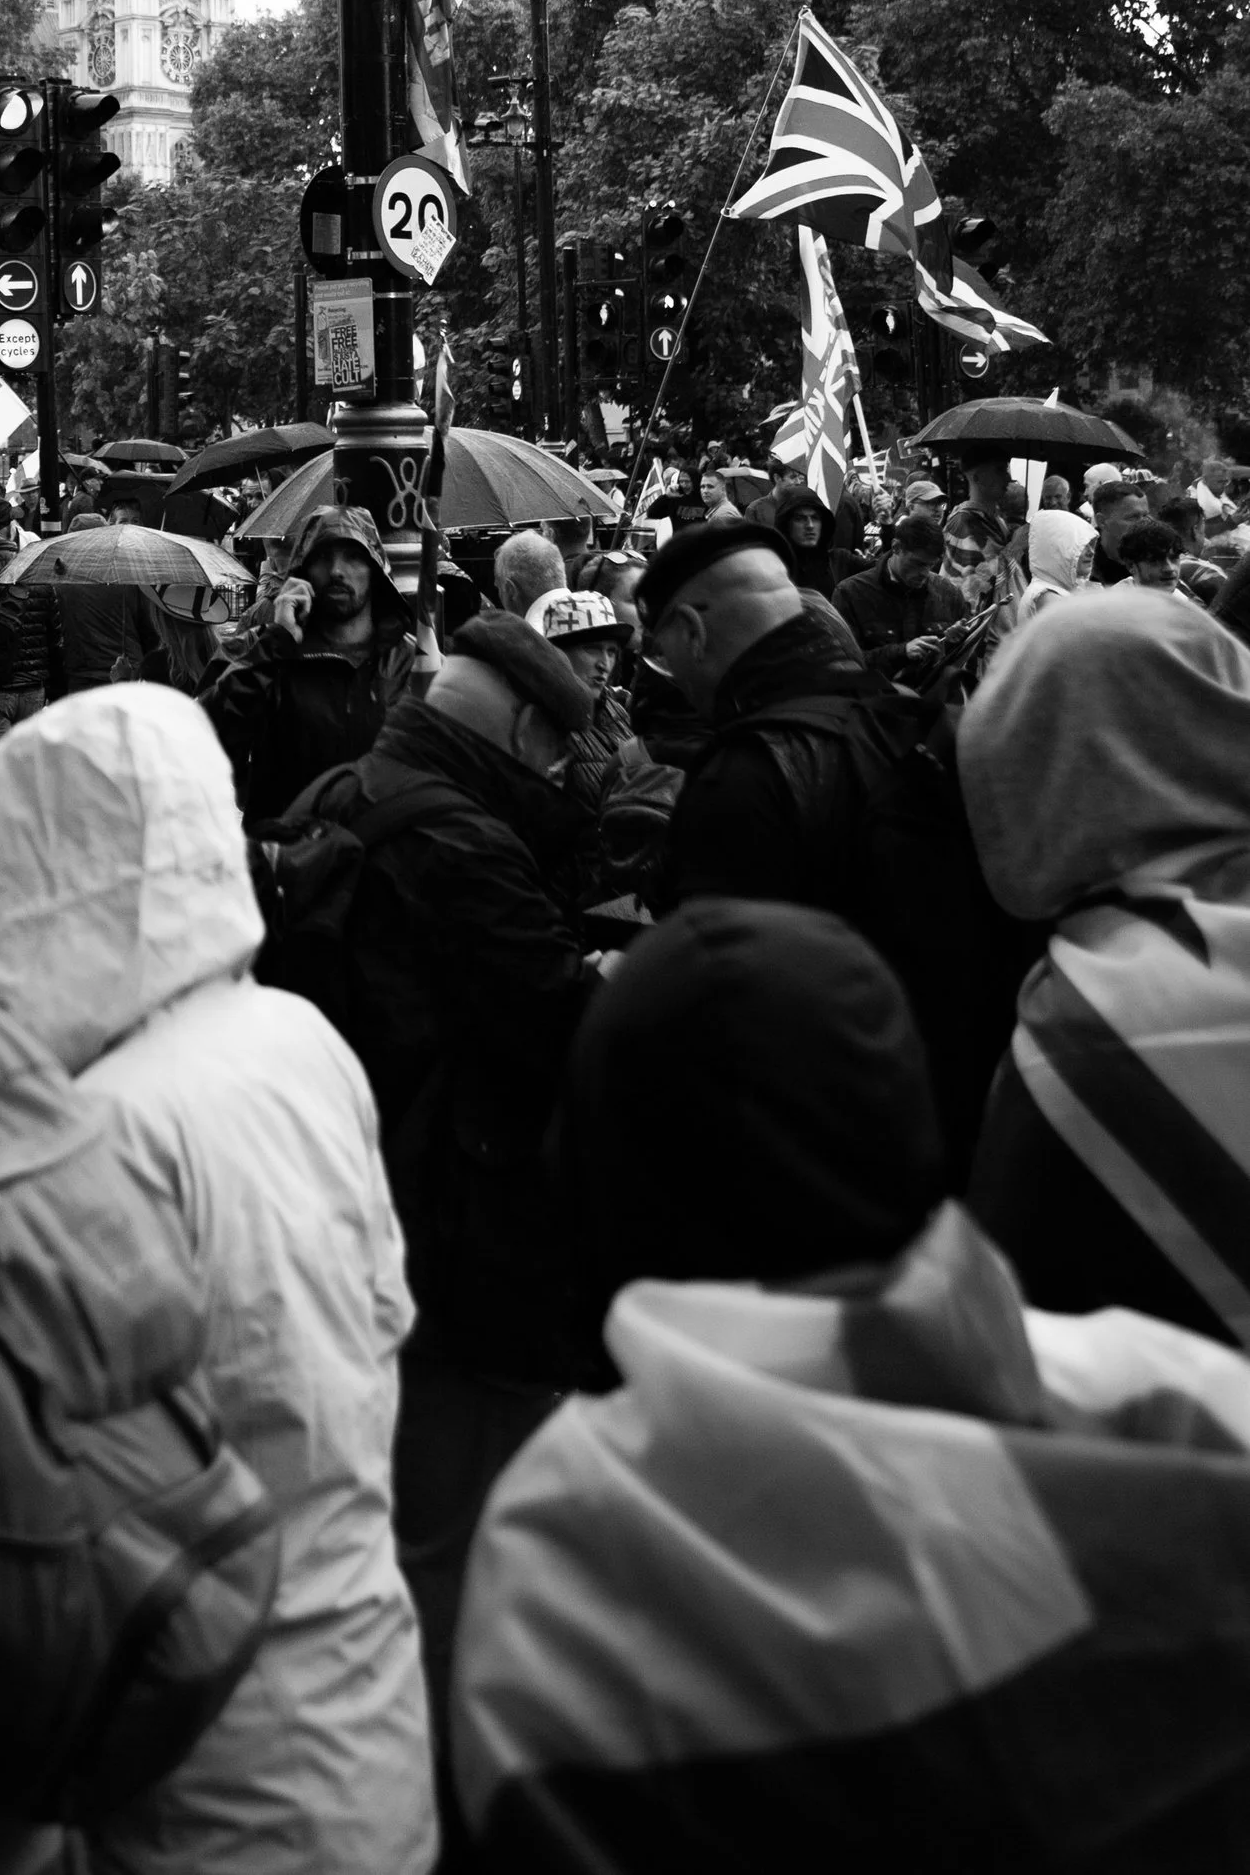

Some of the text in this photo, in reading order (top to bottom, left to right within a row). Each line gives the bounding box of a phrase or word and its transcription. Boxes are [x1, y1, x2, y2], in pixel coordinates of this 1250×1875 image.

[388, 191, 444, 239] 20
[332, 337, 357, 350] FREE
[0, 346, 35, 358] cycles
[333, 359, 360, 373] HATE
[334, 372, 360, 385] CULT
